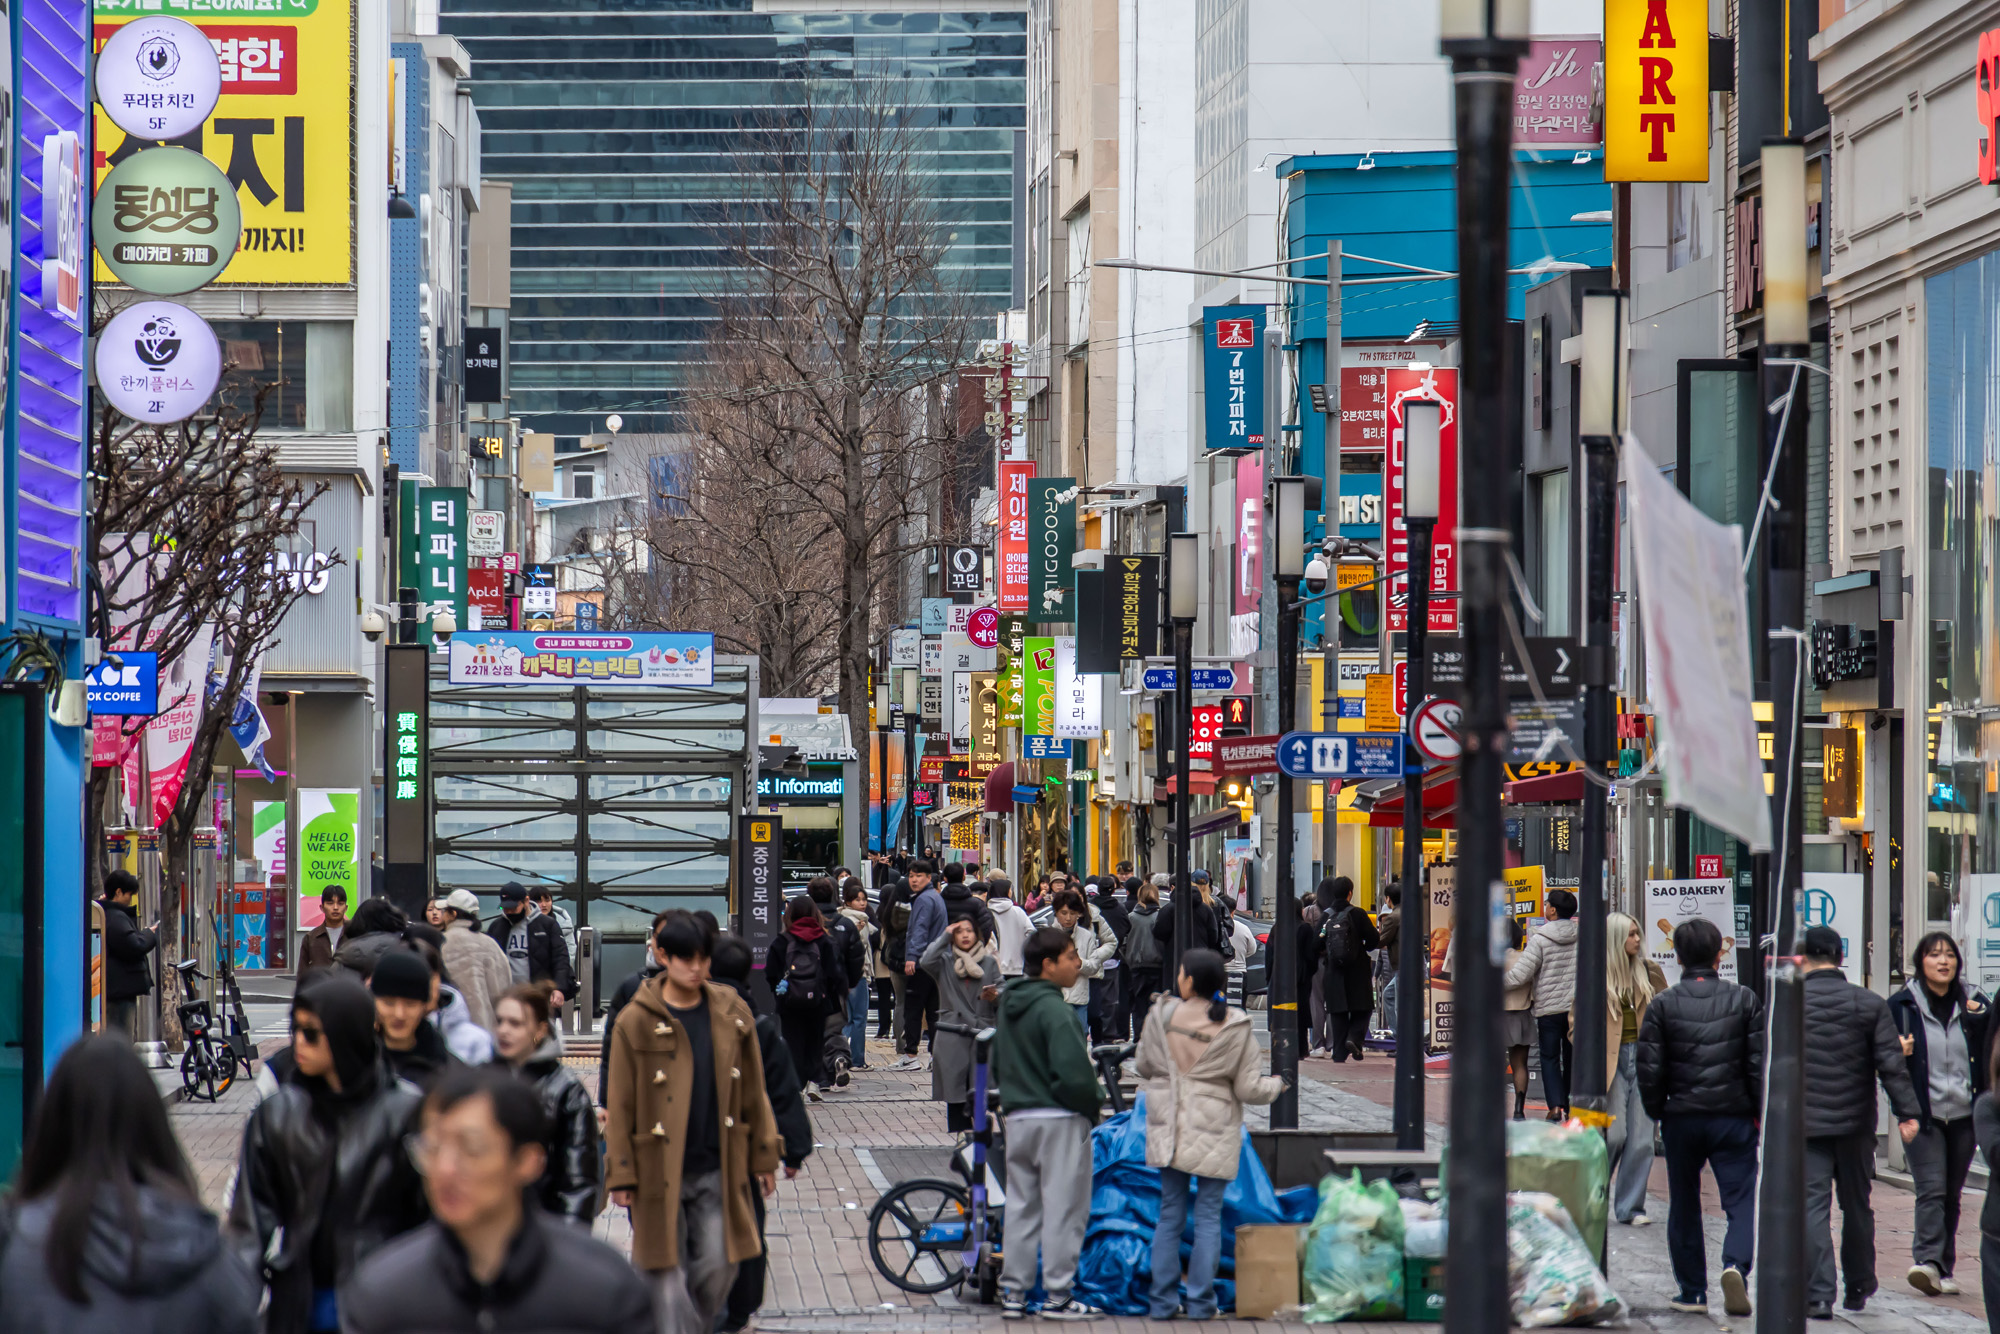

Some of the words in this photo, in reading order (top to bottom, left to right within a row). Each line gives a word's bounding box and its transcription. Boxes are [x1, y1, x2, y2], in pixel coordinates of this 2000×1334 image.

[208, 38, 284, 82] 렴한
[122, 94, 164, 109] 푸라닭
[167, 93, 195, 109] 치킨
[1548, 95, 1588, 109] 김정현
[149, 117, 168, 130] 5F
[122, 246, 172, 263] 베이커리
[182, 248, 209, 264] 카페
[1359, 353, 1371, 361] 7TH
[1373, 352, 1396, 361] STREET
[1398, 351, 1416, 360] PIZZA
[466, 358, 498, 368] 연기학원
[120, 375, 195, 393] 한끼플러스
[1359, 374, 1377, 386] 1인용
[1229, 351, 1247, 436] 7번가피자
[148, 401, 165, 413] 2F
[1008, 473, 1027, 541] 제이원
[1361, 495, 1382, 524] ST
[475, 515, 495, 525] CCR
[1044, 487, 1059, 592] CROCODIL
[1006, 563, 1028, 573] 오디션
[952, 573, 979, 588] 꾸민
[1006, 574, 1028, 584] 입시반
[1121, 572, 1141, 657] 한국공인금거래소
[577, 639, 599, 648] 캐릭터
[602, 639, 623, 648] 상점가
[464, 665, 489, 676] 22개
[491, 665, 513, 676] 상점
[522, 654, 572, 677] 캐릭터
[575, 657, 642, 678] 스트리트
[1072, 656, 1086, 720] 사밀라
[86, 692, 101, 702] OK
[104, 692, 141, 702] COFFEE
[982, 703, 996, 747] 럭셔리
[1030, 737, 1065, 756] 폼프
[1221, 744, 1277, 761] 동성로관광특
[396, 712, 418, 799] 質優價廉
[977, 753, 1001, 761] 귀금속
[756, 779, 770, 794] st
[309, 833, 349, 842] HELLO
[307, 843, 326, 852] WE
[328, 843, 351, 852] ARE
[311, 861, 346, 870] OLIVE
[1701, 864, 1718, 872] TAX
[308, 871, 351, 880] YOUNG
[752, 847, 769, 924] 중앙로역
[1514, 879, 1527, 887] DAY
[1653, 887, 1677, 896] SAO
[1680, 886, 1726, 896] BAKERY
